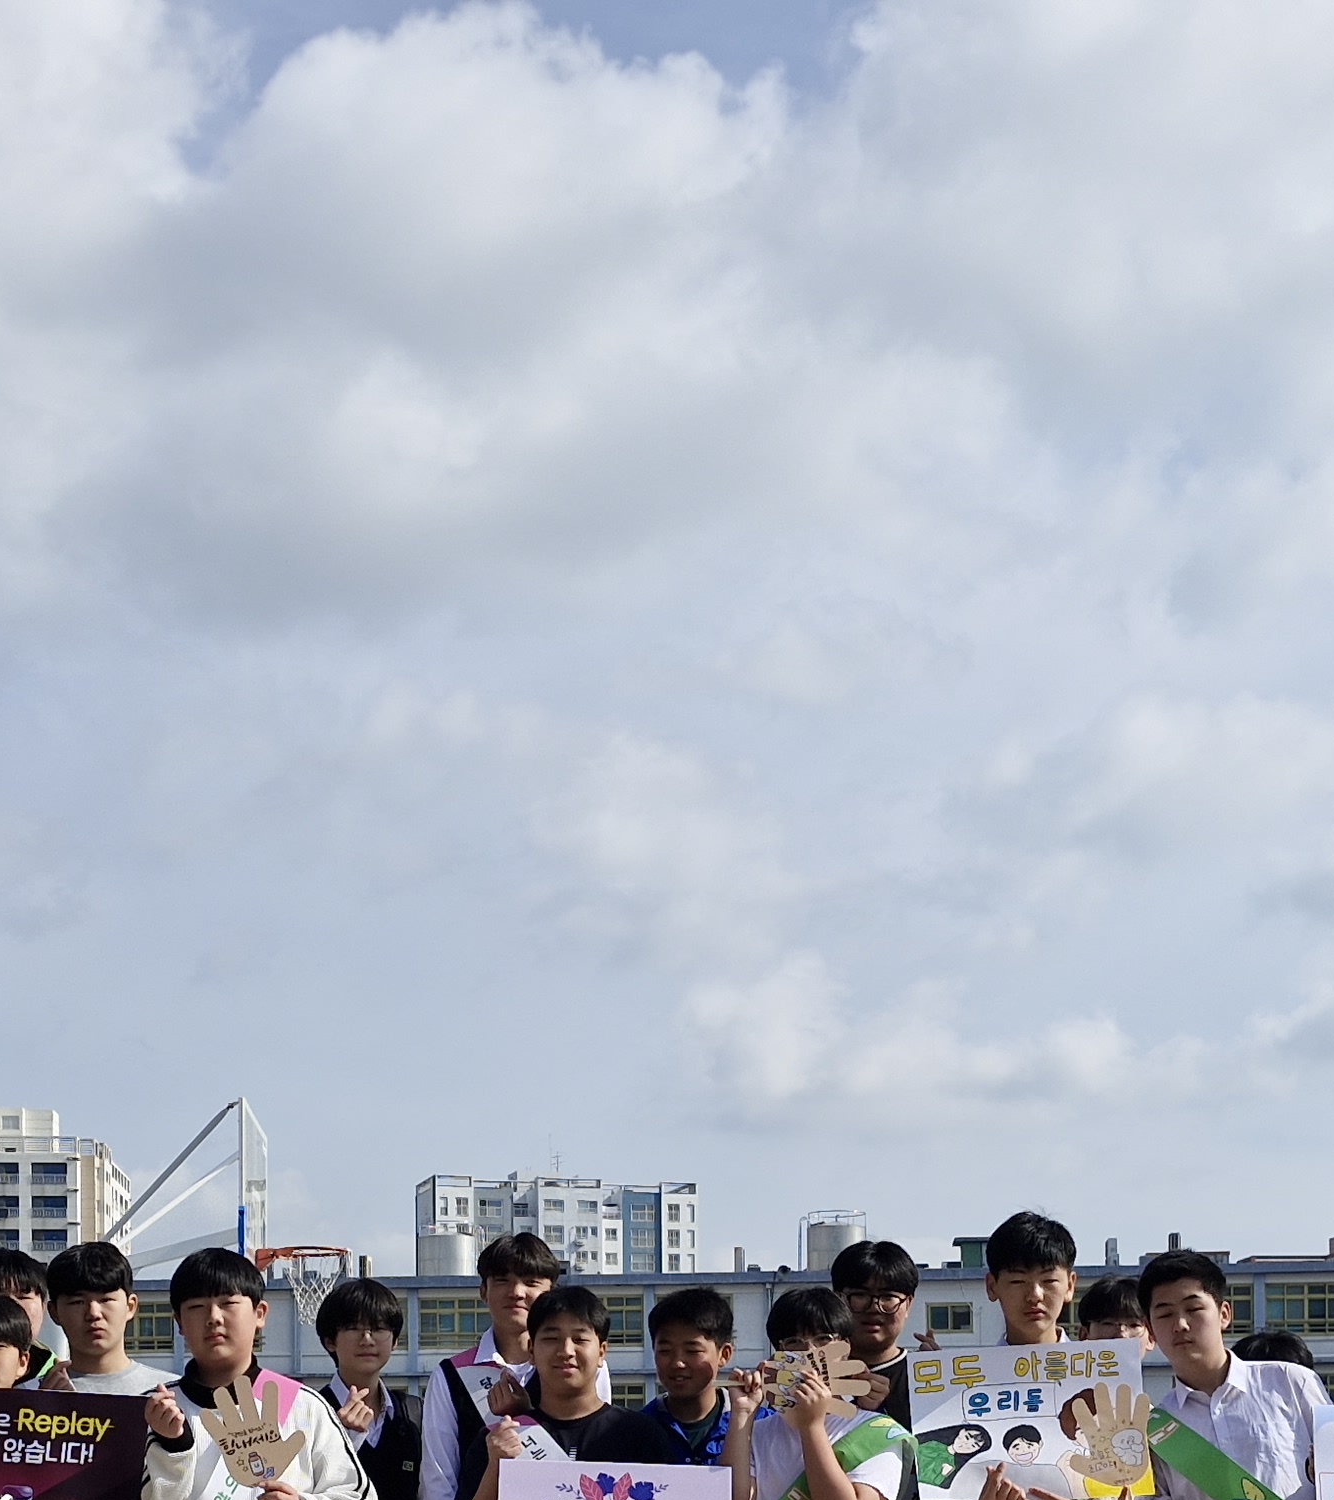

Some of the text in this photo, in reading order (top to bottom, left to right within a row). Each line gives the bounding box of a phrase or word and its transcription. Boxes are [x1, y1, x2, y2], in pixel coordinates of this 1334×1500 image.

[912, 1350, 1120, 1395] 모두 아름다운
[16, 1407, 112, 1442] Replay
[2, 1437, 95, 1465] 않습니다!
